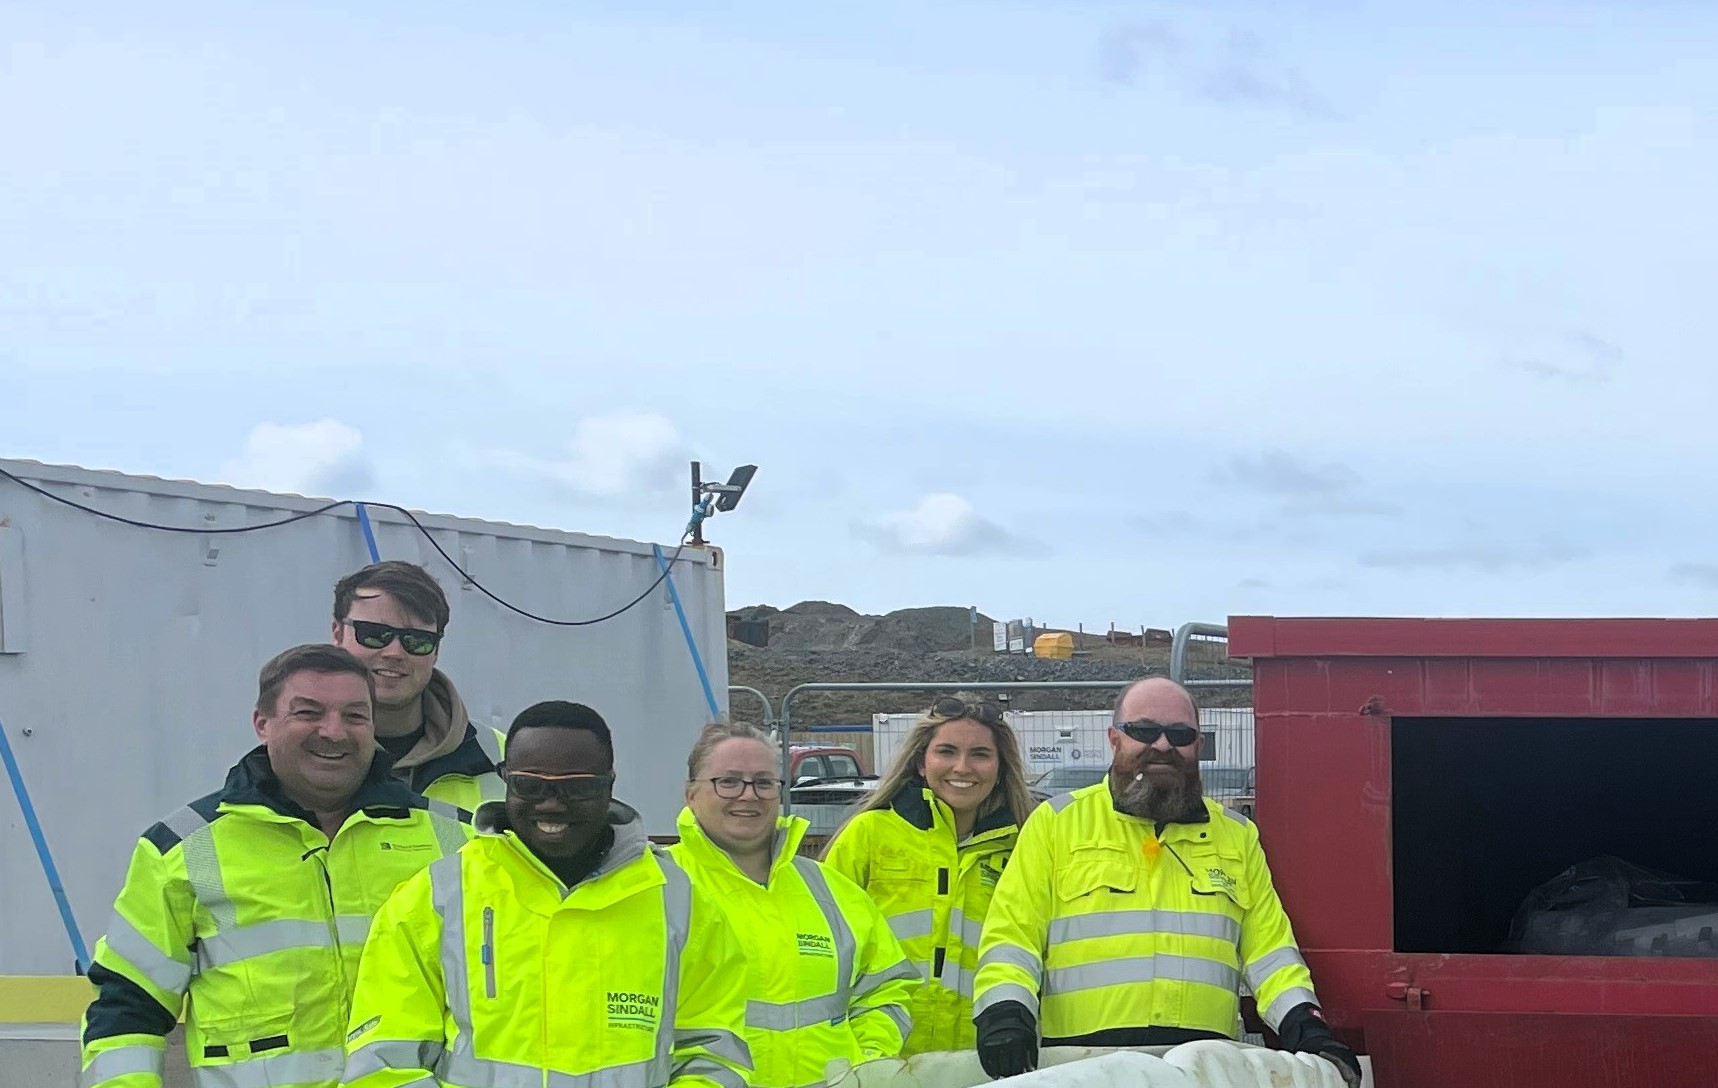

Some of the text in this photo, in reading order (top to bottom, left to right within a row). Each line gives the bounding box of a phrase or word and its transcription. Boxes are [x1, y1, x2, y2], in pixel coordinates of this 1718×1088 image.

[1029, 746, 1062, 754] MORGAN
[606, 991, 660, 1008] MORGAN
[606, 1003, 656, 1019] SINDALL
